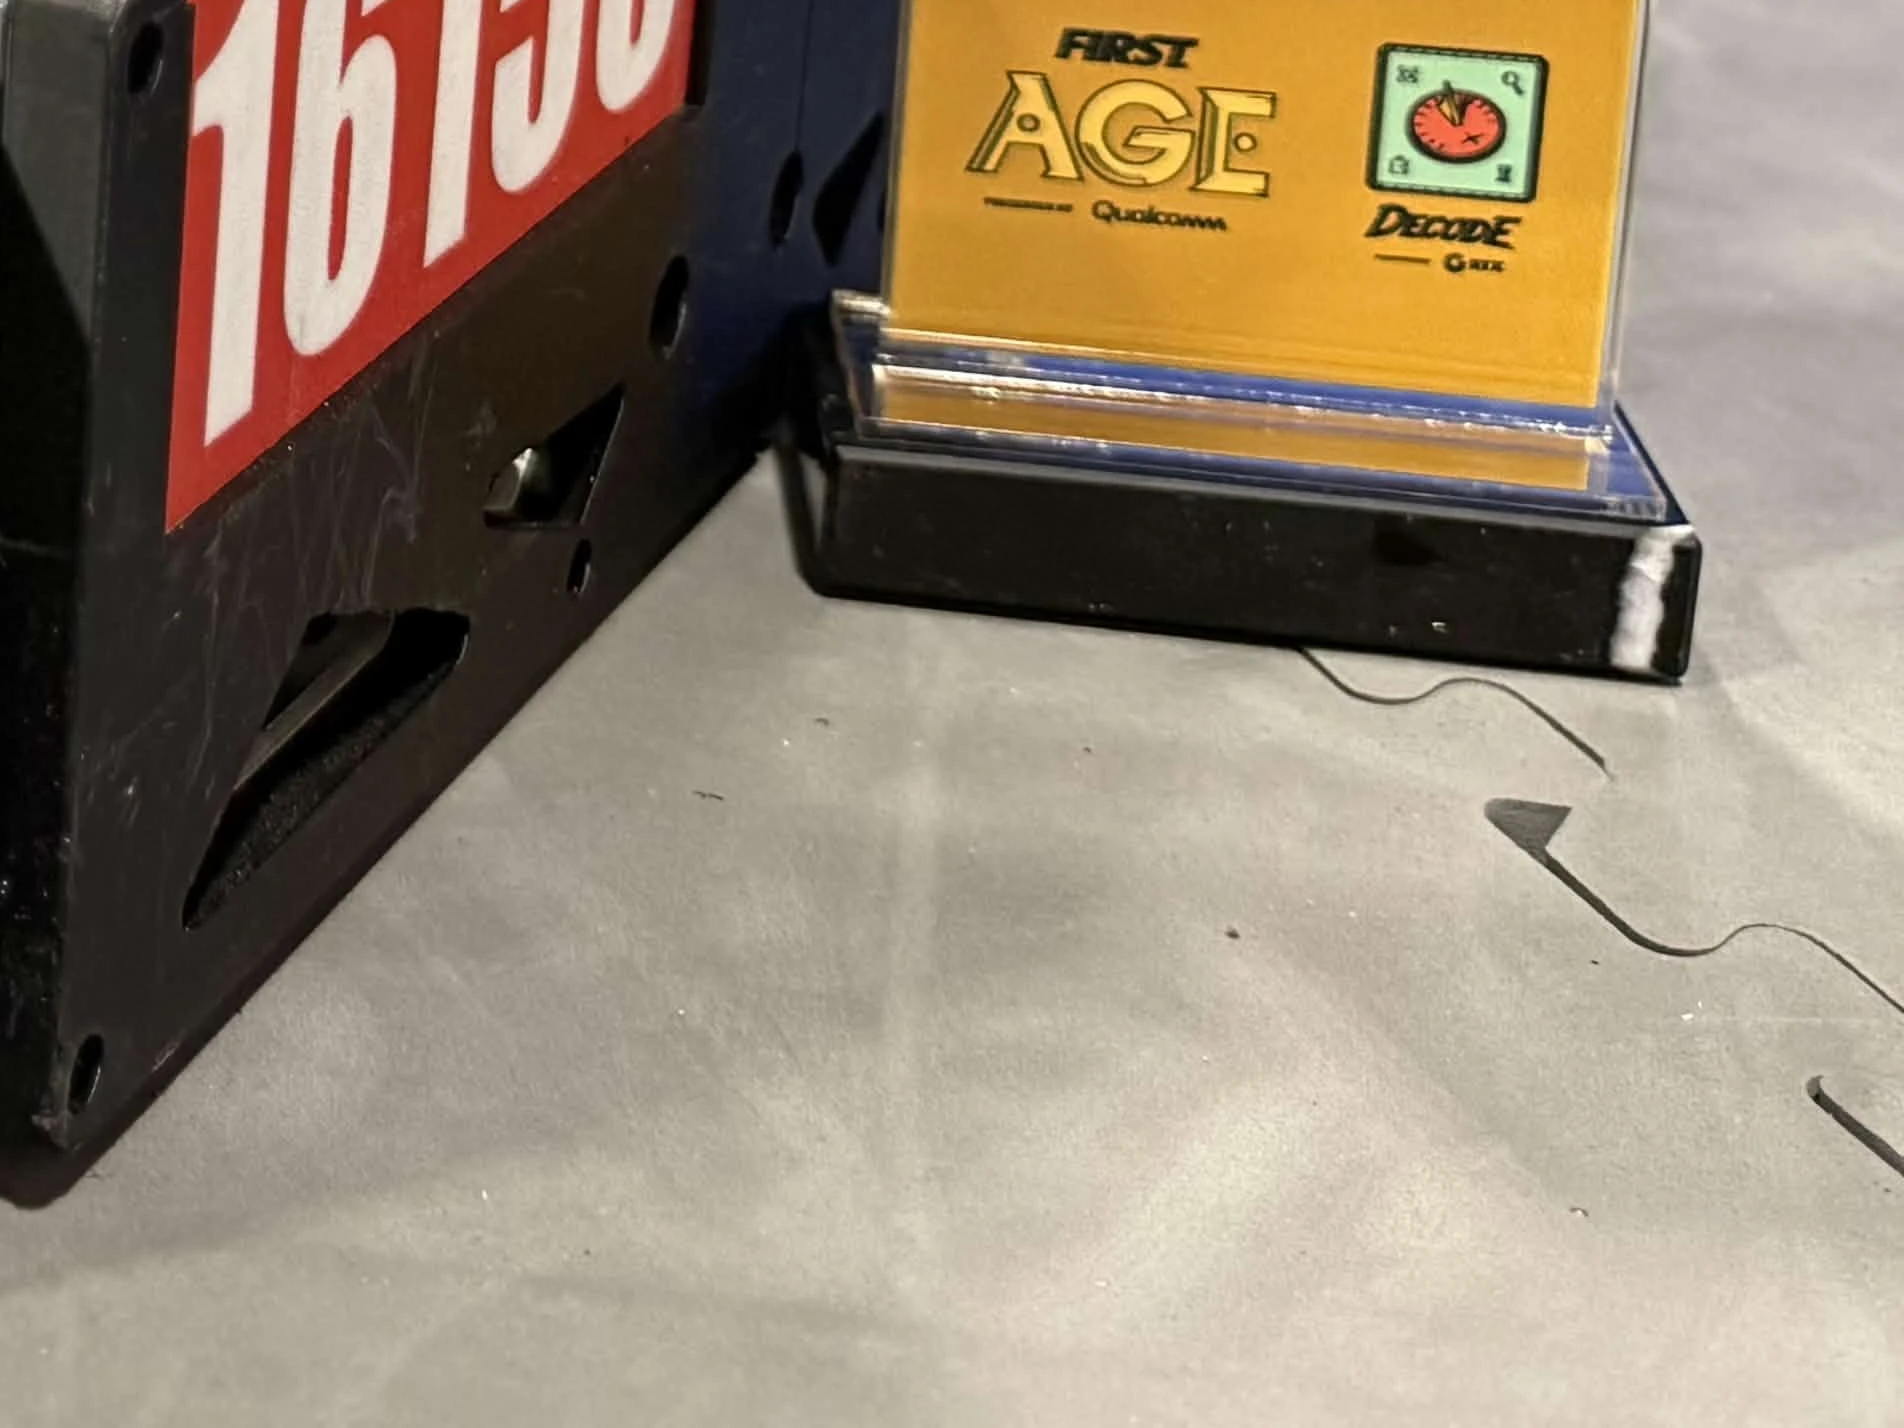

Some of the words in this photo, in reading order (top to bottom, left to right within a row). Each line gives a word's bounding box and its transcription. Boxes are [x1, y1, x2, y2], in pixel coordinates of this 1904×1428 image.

[1055, 26, 1200, 69] FIRST
[965, 69, 1277, 198] AGE
[1363, 202, 1523, 250] DECODE
